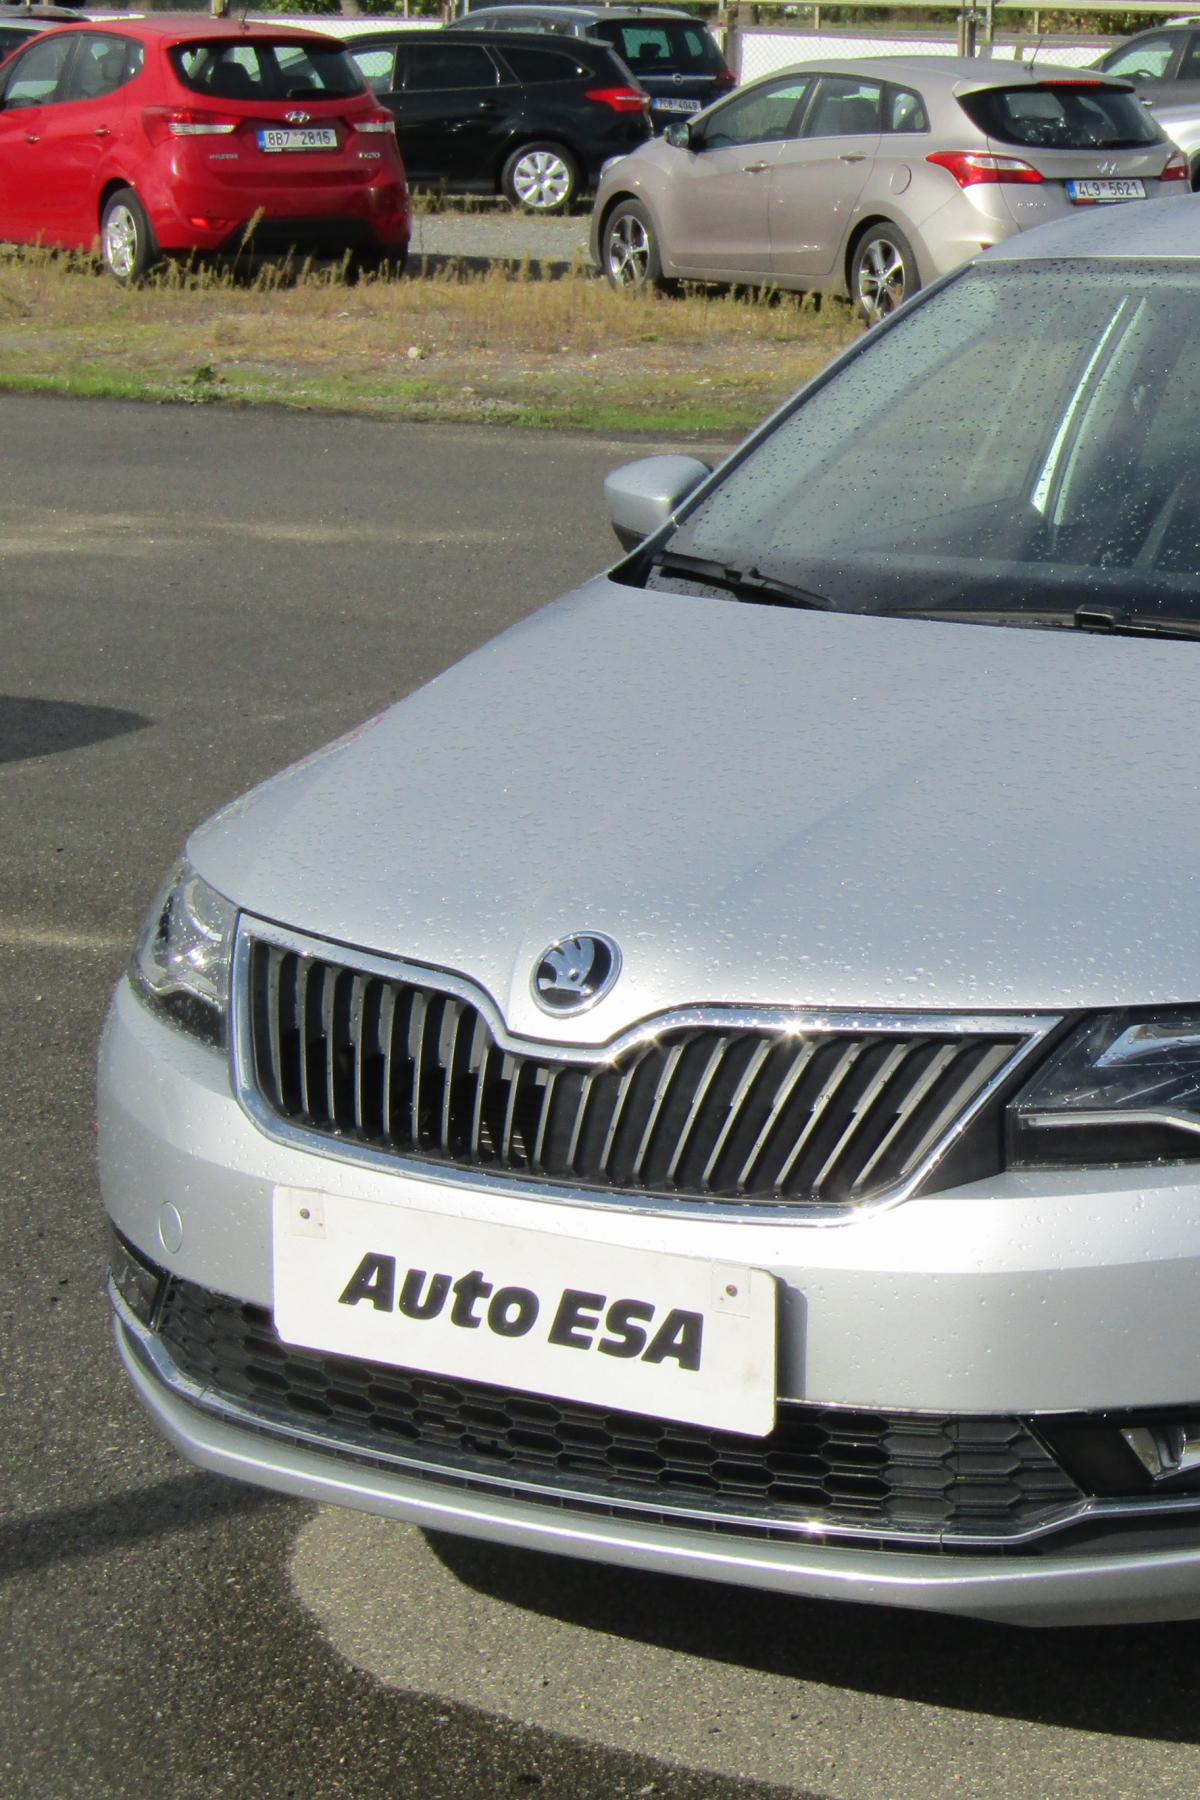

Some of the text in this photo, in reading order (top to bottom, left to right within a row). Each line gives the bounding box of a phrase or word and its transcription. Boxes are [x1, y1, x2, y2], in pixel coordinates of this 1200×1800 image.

[268, 130, 331, 146] 8B7 2815
[1078, 182, 1139, 197] 4L9 5621
[338, 1252, 705, 1372] Auto ESA
